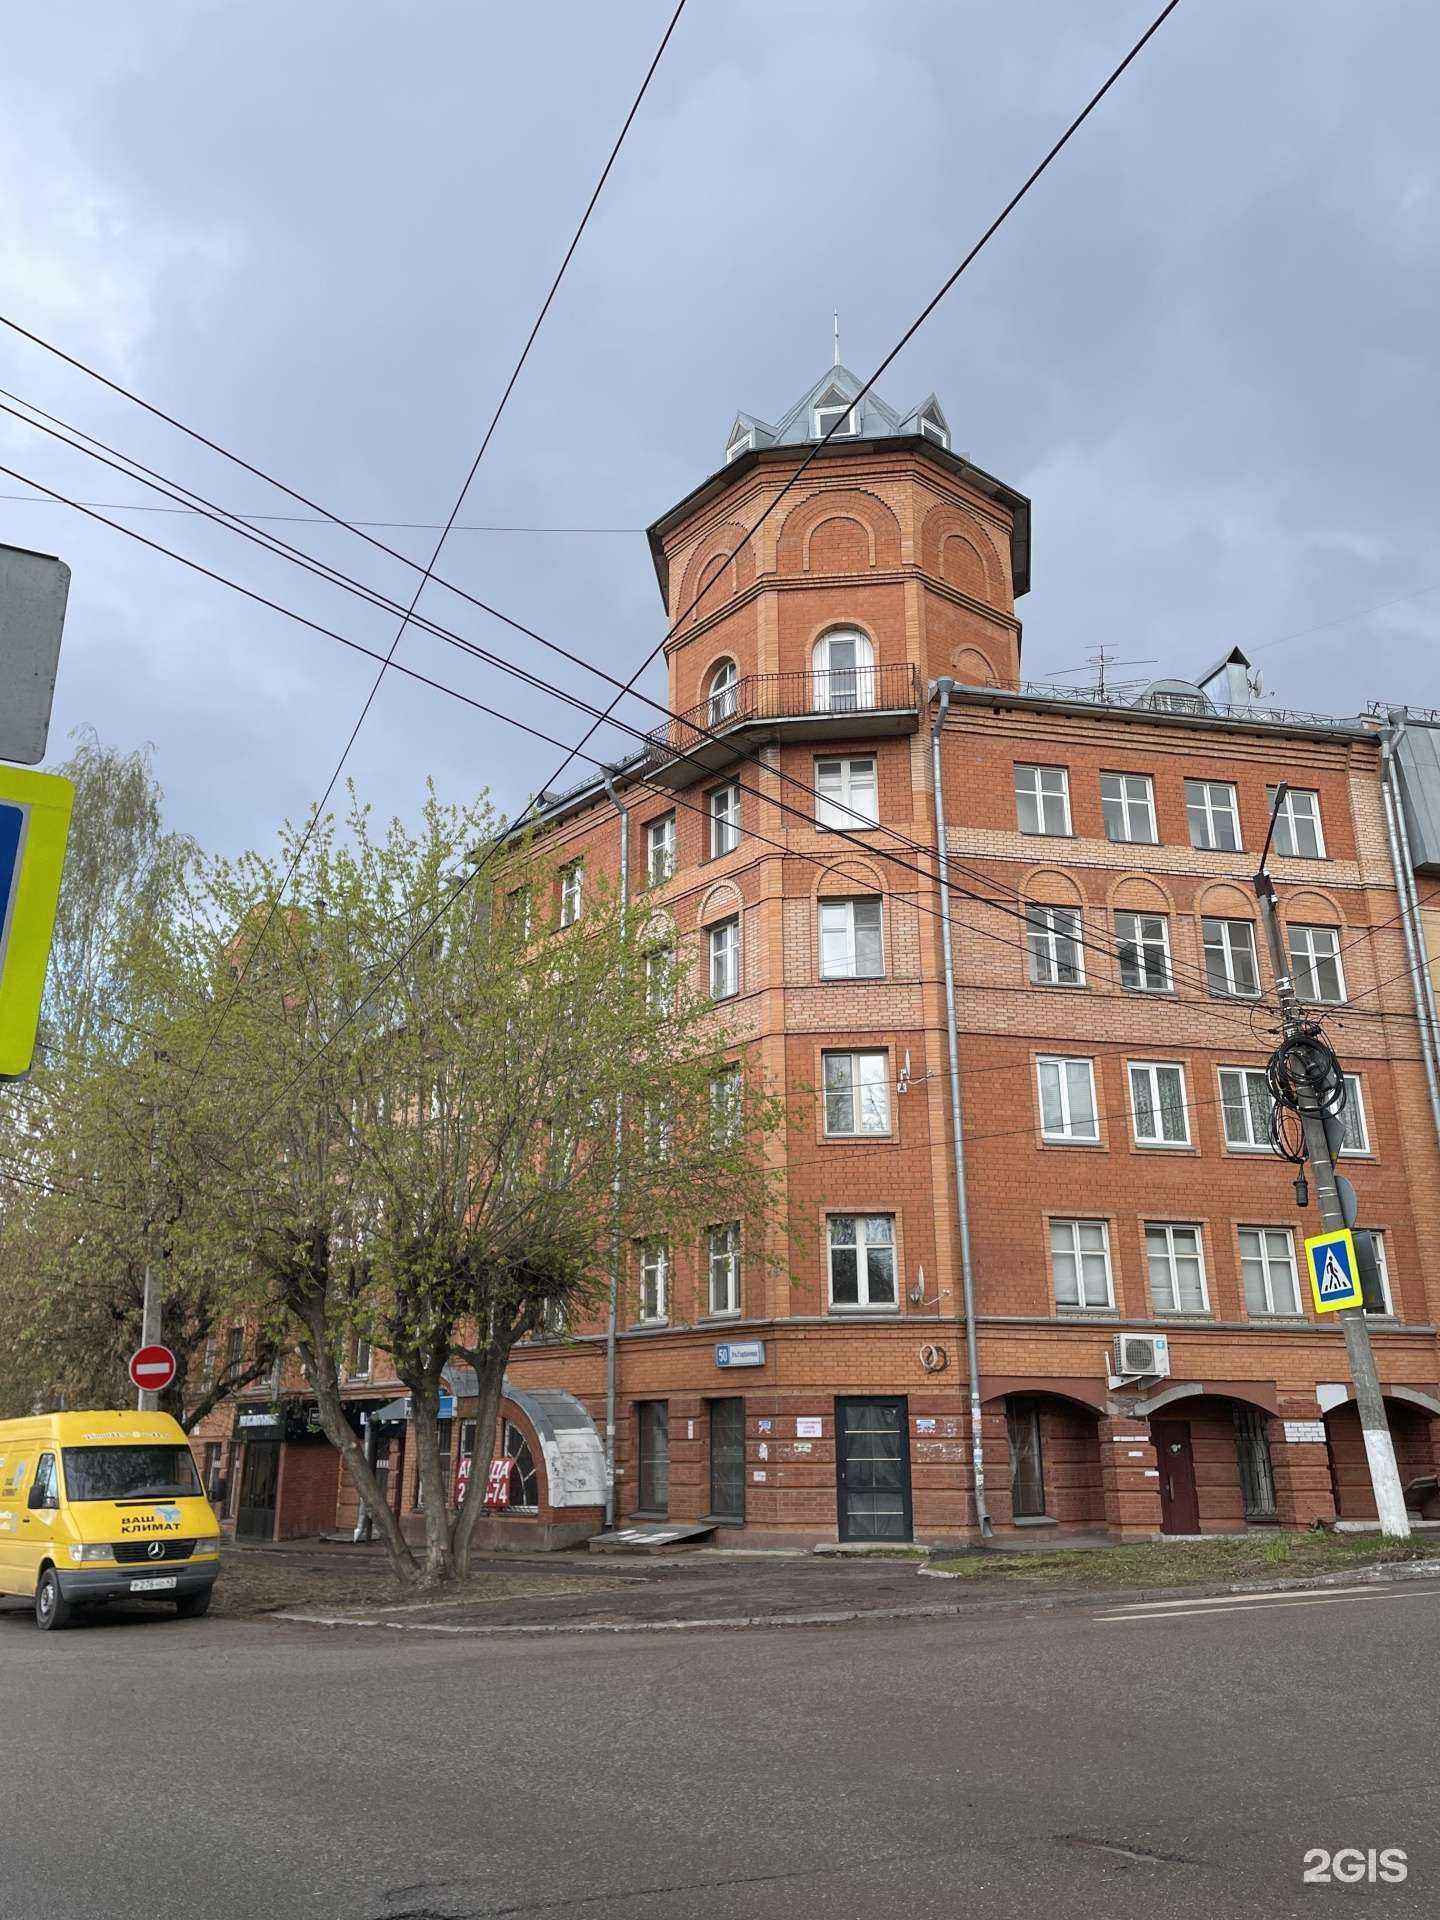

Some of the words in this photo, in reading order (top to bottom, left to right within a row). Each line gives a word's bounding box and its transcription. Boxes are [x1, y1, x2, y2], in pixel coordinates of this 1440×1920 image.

[718, 1348, 728, 1362] 50
[121, 1515, 155, 1525] ВАШ
[121, 1523, 181, 1534] КЛИМАТ
